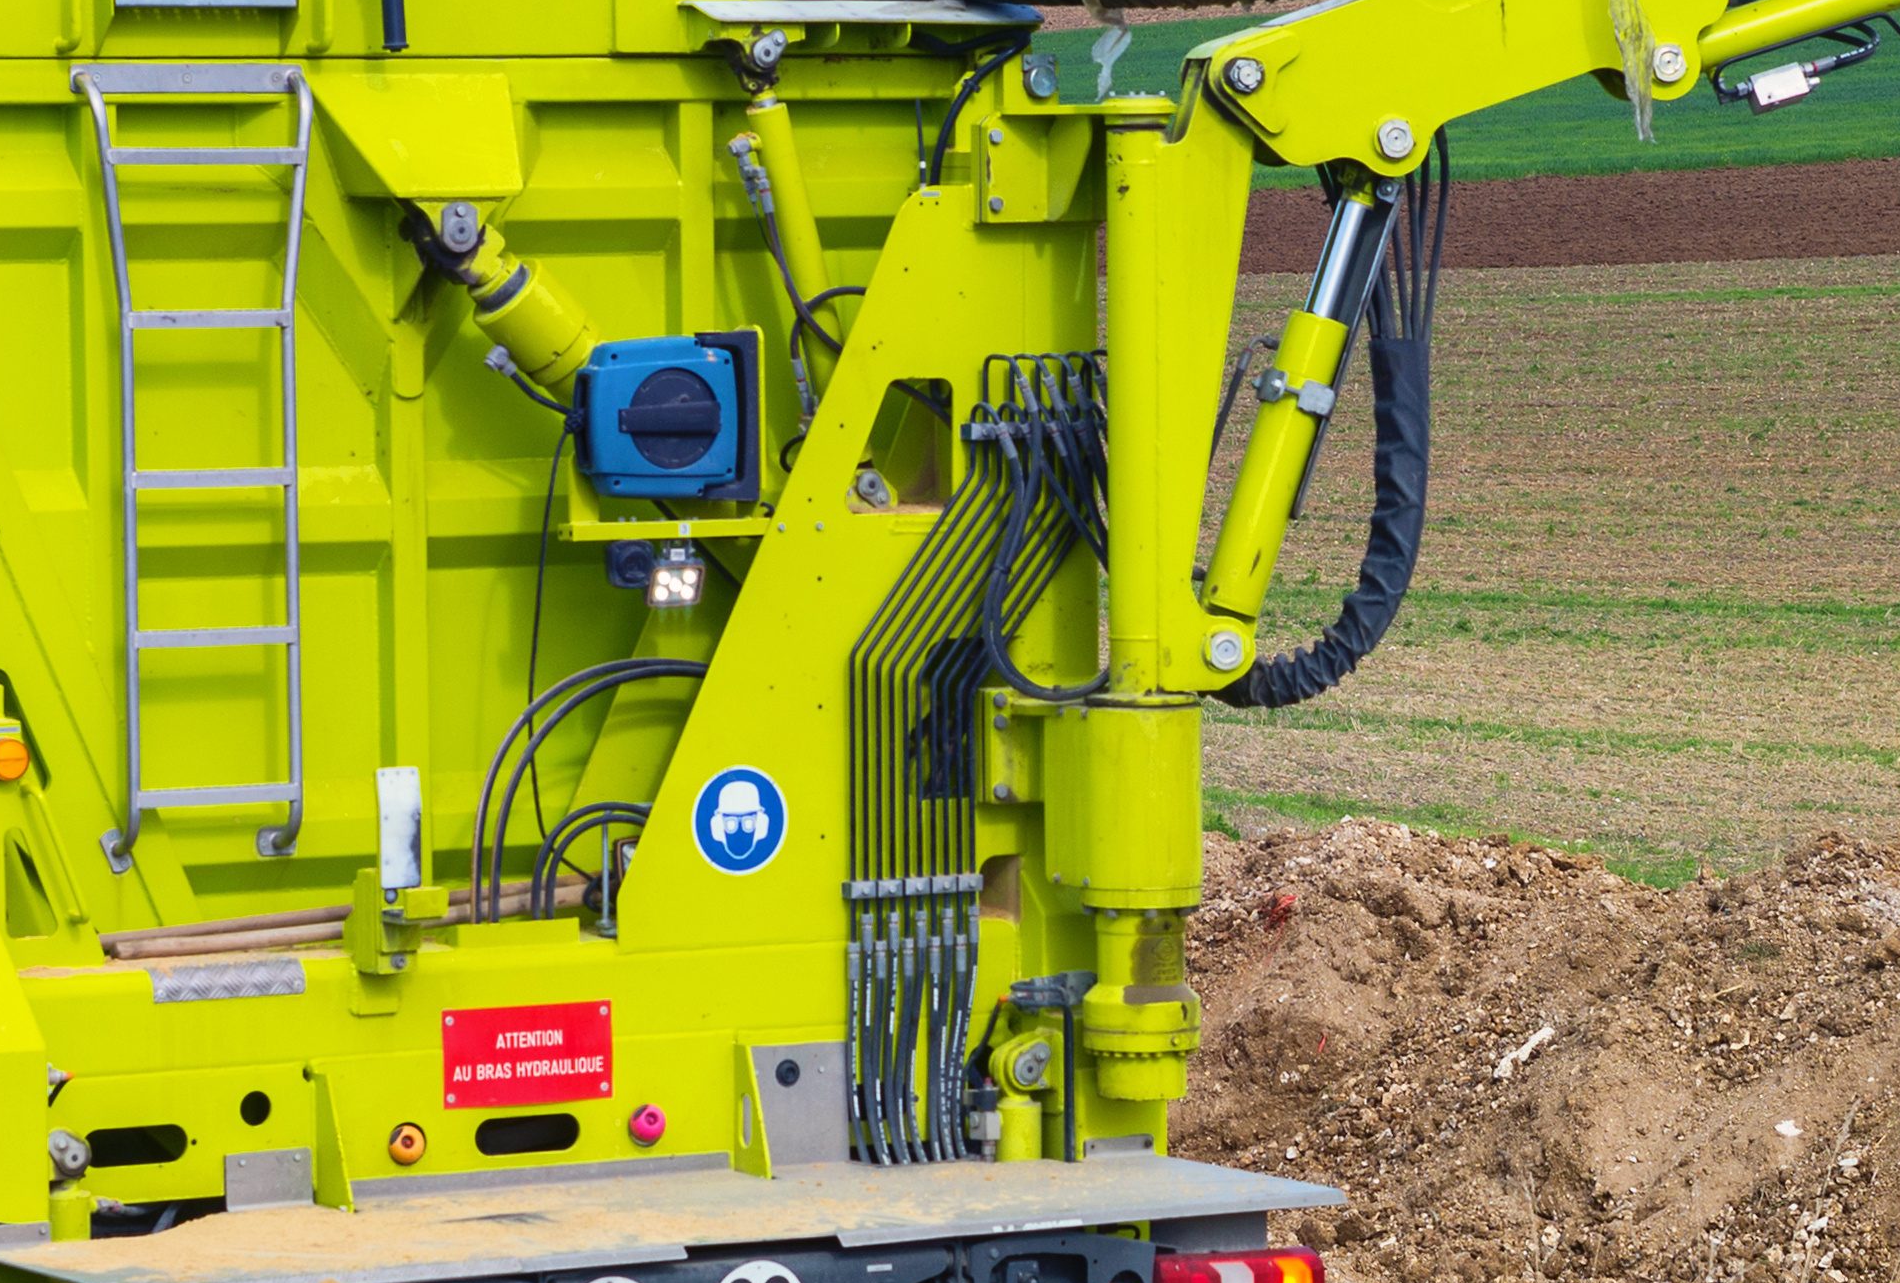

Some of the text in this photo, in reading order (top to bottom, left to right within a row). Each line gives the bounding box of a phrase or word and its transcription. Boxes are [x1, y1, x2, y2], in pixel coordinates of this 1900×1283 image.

[495, 1029, 563, 1049] ATTENTION
[453, 1056, 604, 1082] AU BRAS HYDRAULIQUE
